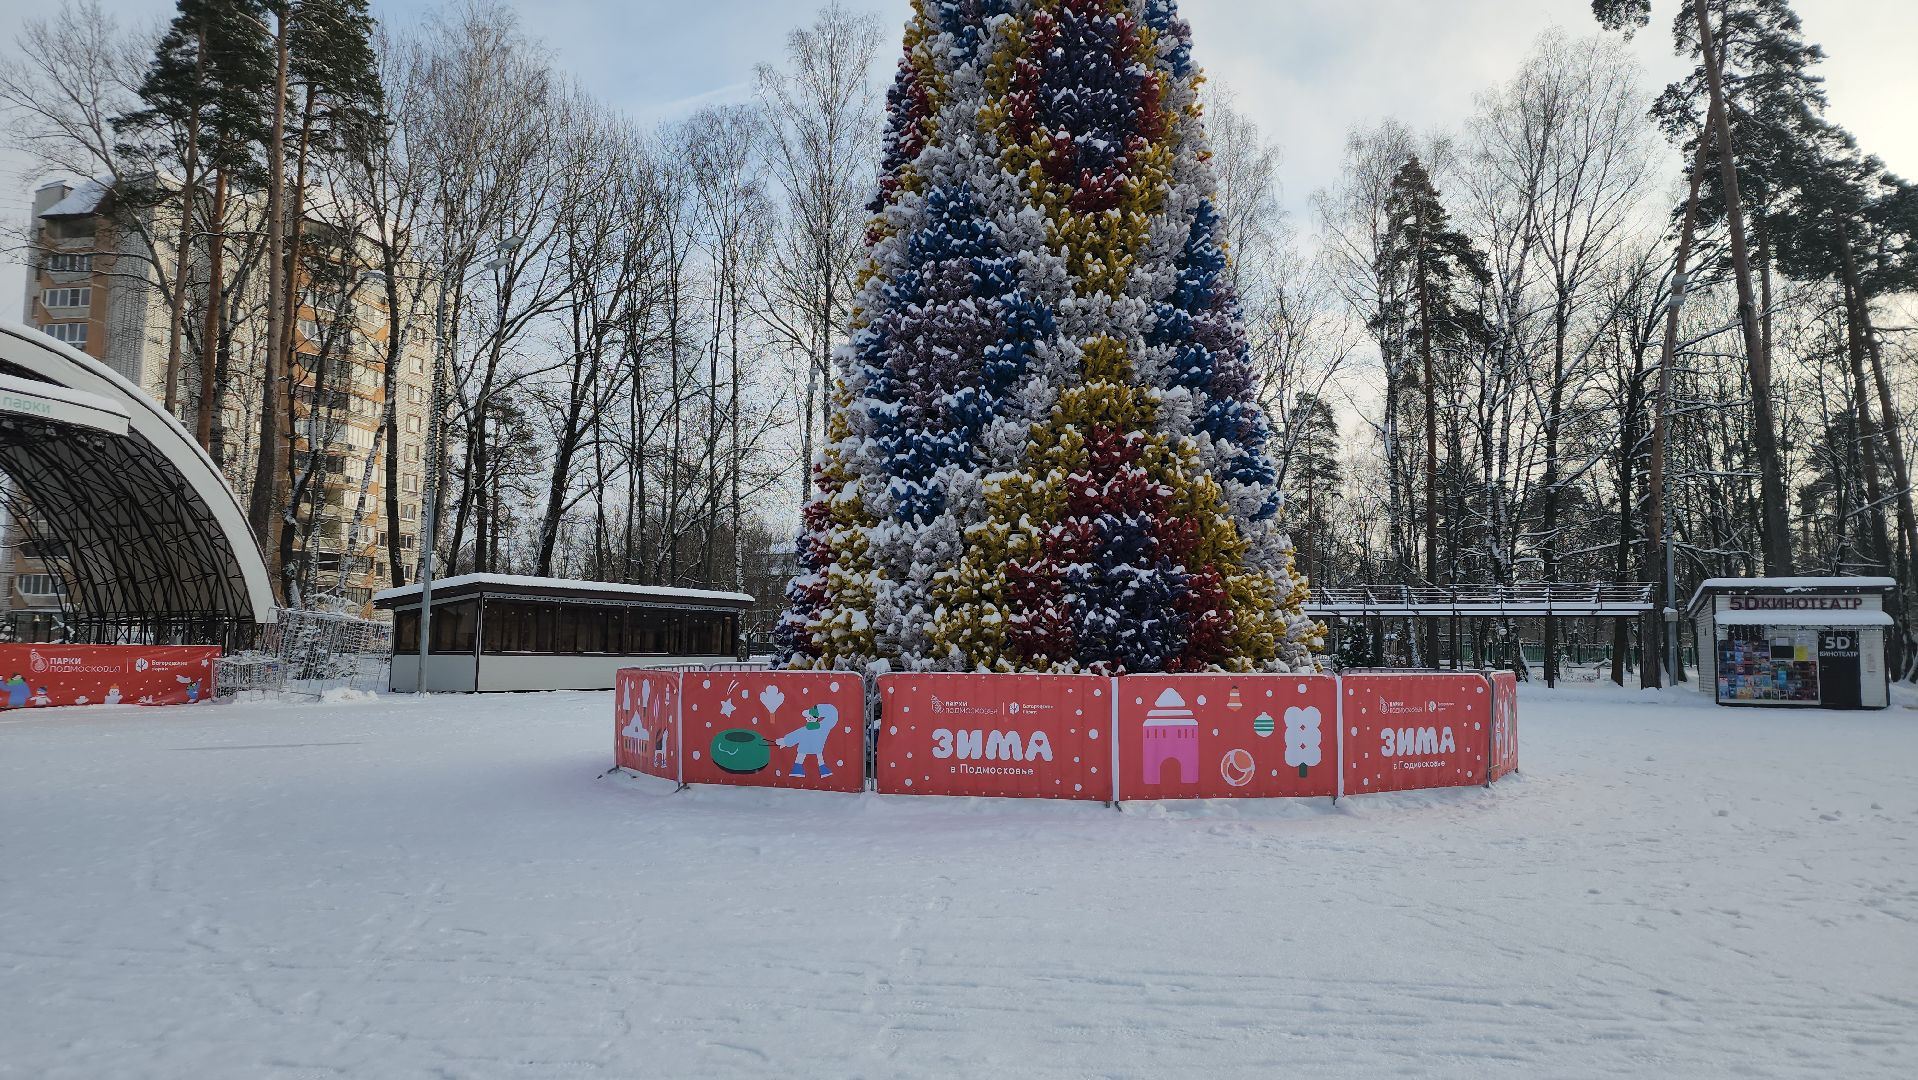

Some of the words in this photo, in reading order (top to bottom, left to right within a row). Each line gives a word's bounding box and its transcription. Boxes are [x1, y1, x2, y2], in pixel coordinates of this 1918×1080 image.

[3, 396, 51, 414] парки
[1825, 636, 1850, 649] 5D
[49, 657, 81, 665] ПАРКИ
[932, 728, 1053, 762] ЗИМА
[1380, 727, 1456, 757] ЗИМА
[960, 763, 1034, 775] Подмосковье
